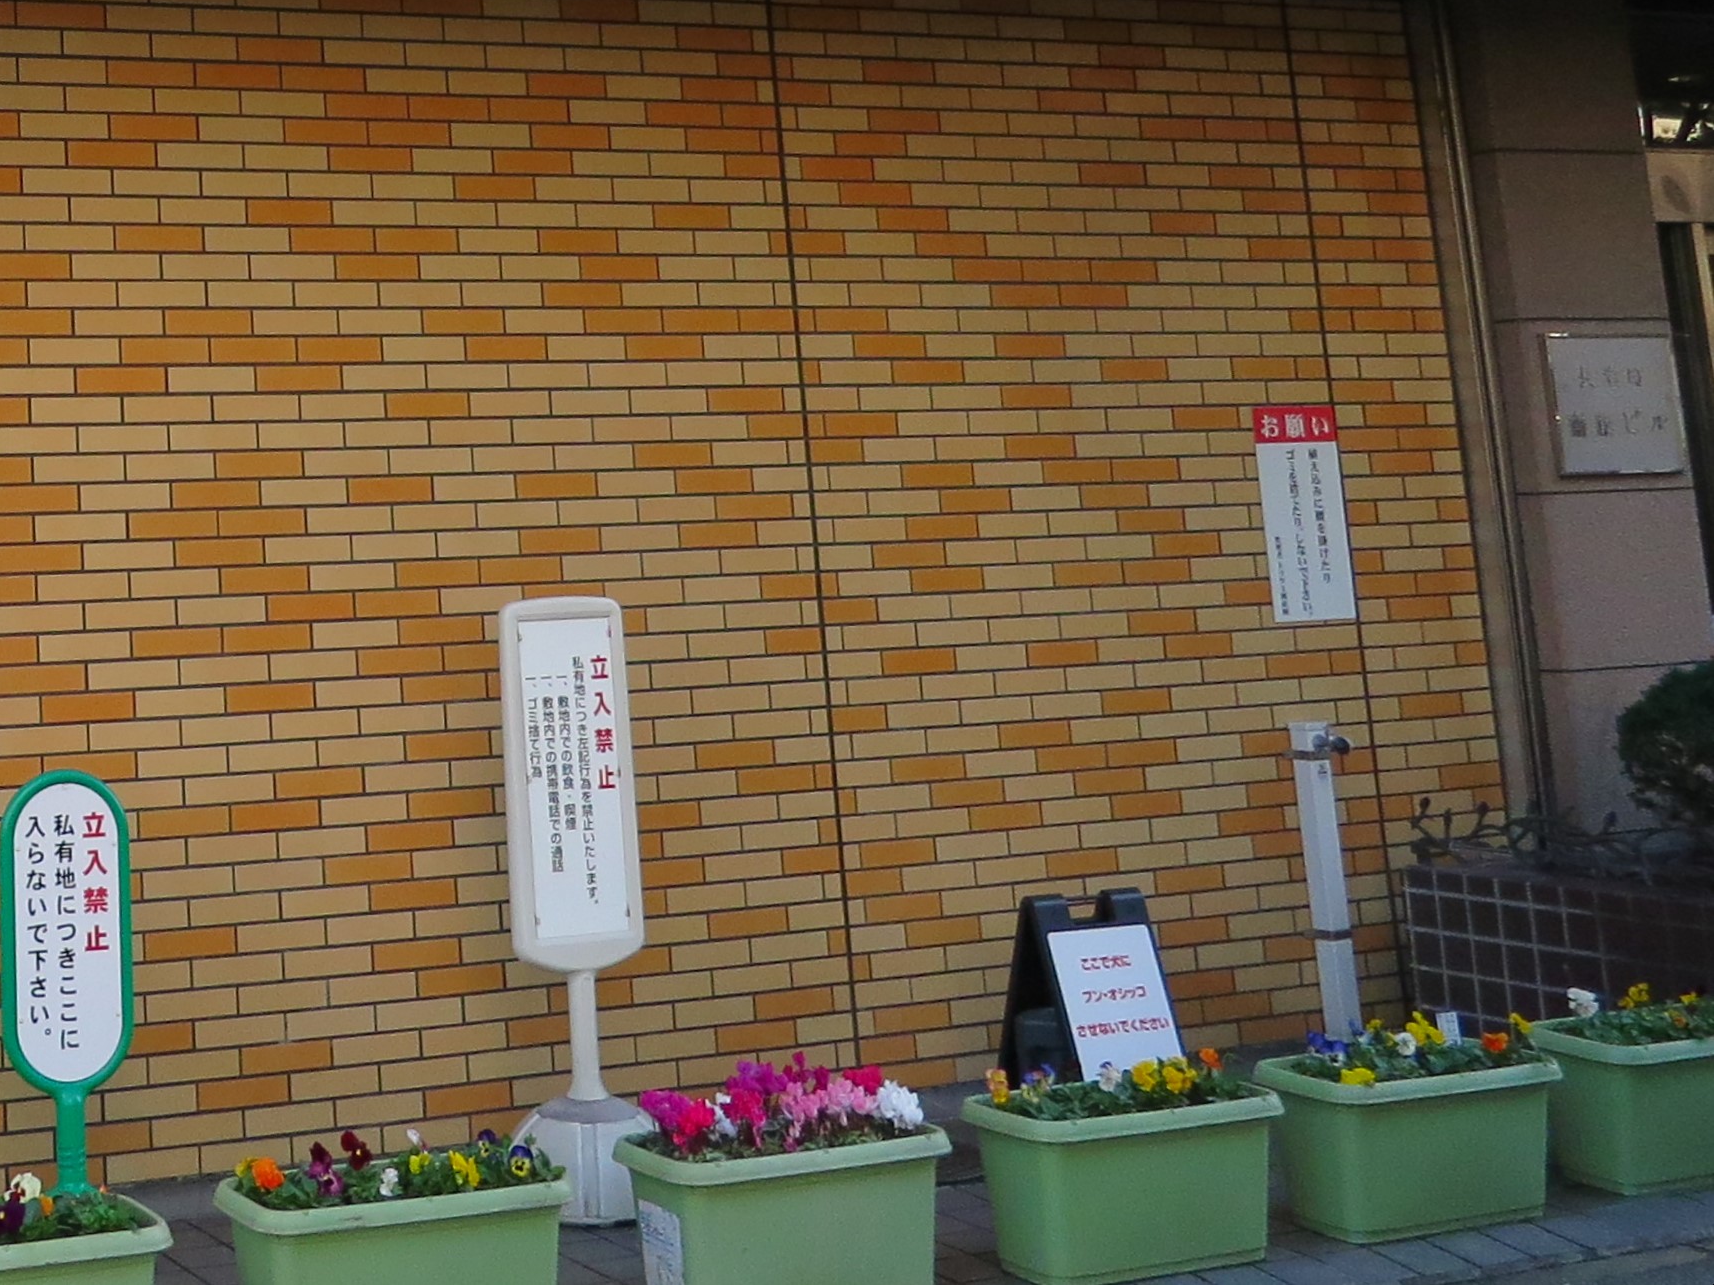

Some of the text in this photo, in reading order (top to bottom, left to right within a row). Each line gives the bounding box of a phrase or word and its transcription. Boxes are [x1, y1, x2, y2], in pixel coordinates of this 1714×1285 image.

[1261, 413, 1329, 438] お願い
[590, 655, 616, 790] 立入禁止
[82, 812, 109, 952] 立入禁止
[25, 816, 51, 1037] 入らないで下さい。
[54, 814, 79, 1050] 私有地につきここに
[1080, 955, 1131, 971] ここで犬に
[1076, 1017, 1169, 1038] させないでください
[1082, 985, 1147, 1004] フン・オシッコ
